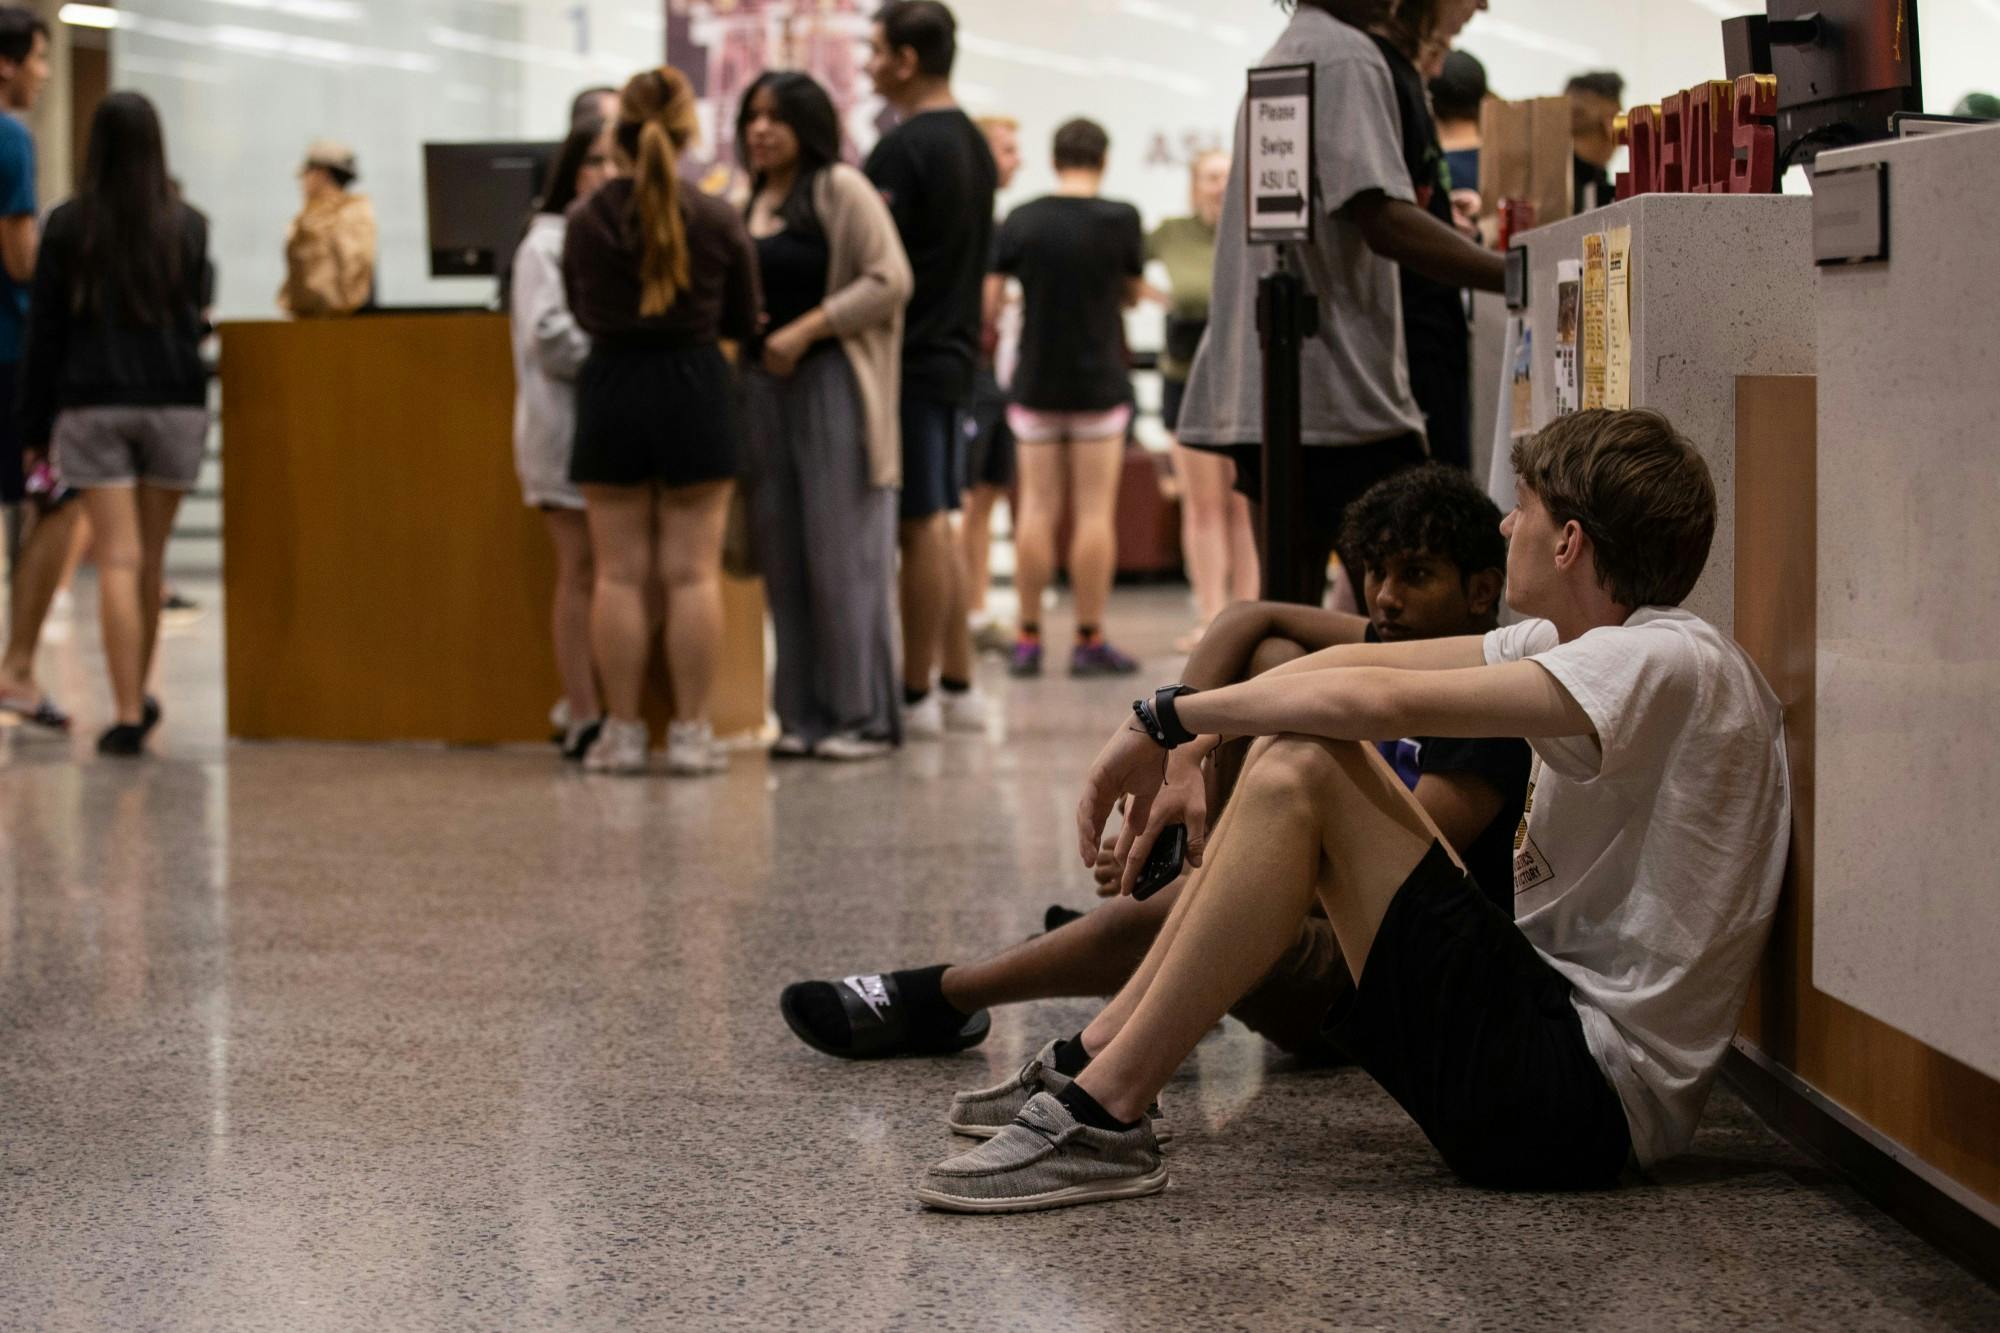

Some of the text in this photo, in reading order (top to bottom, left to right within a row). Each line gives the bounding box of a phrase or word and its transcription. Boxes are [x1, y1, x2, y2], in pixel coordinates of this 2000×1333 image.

[1258, 102, 1296, 122] Please
[1260, 136, 1294, 159] Swipe
[1260, 170, 1283, 189] ASU
